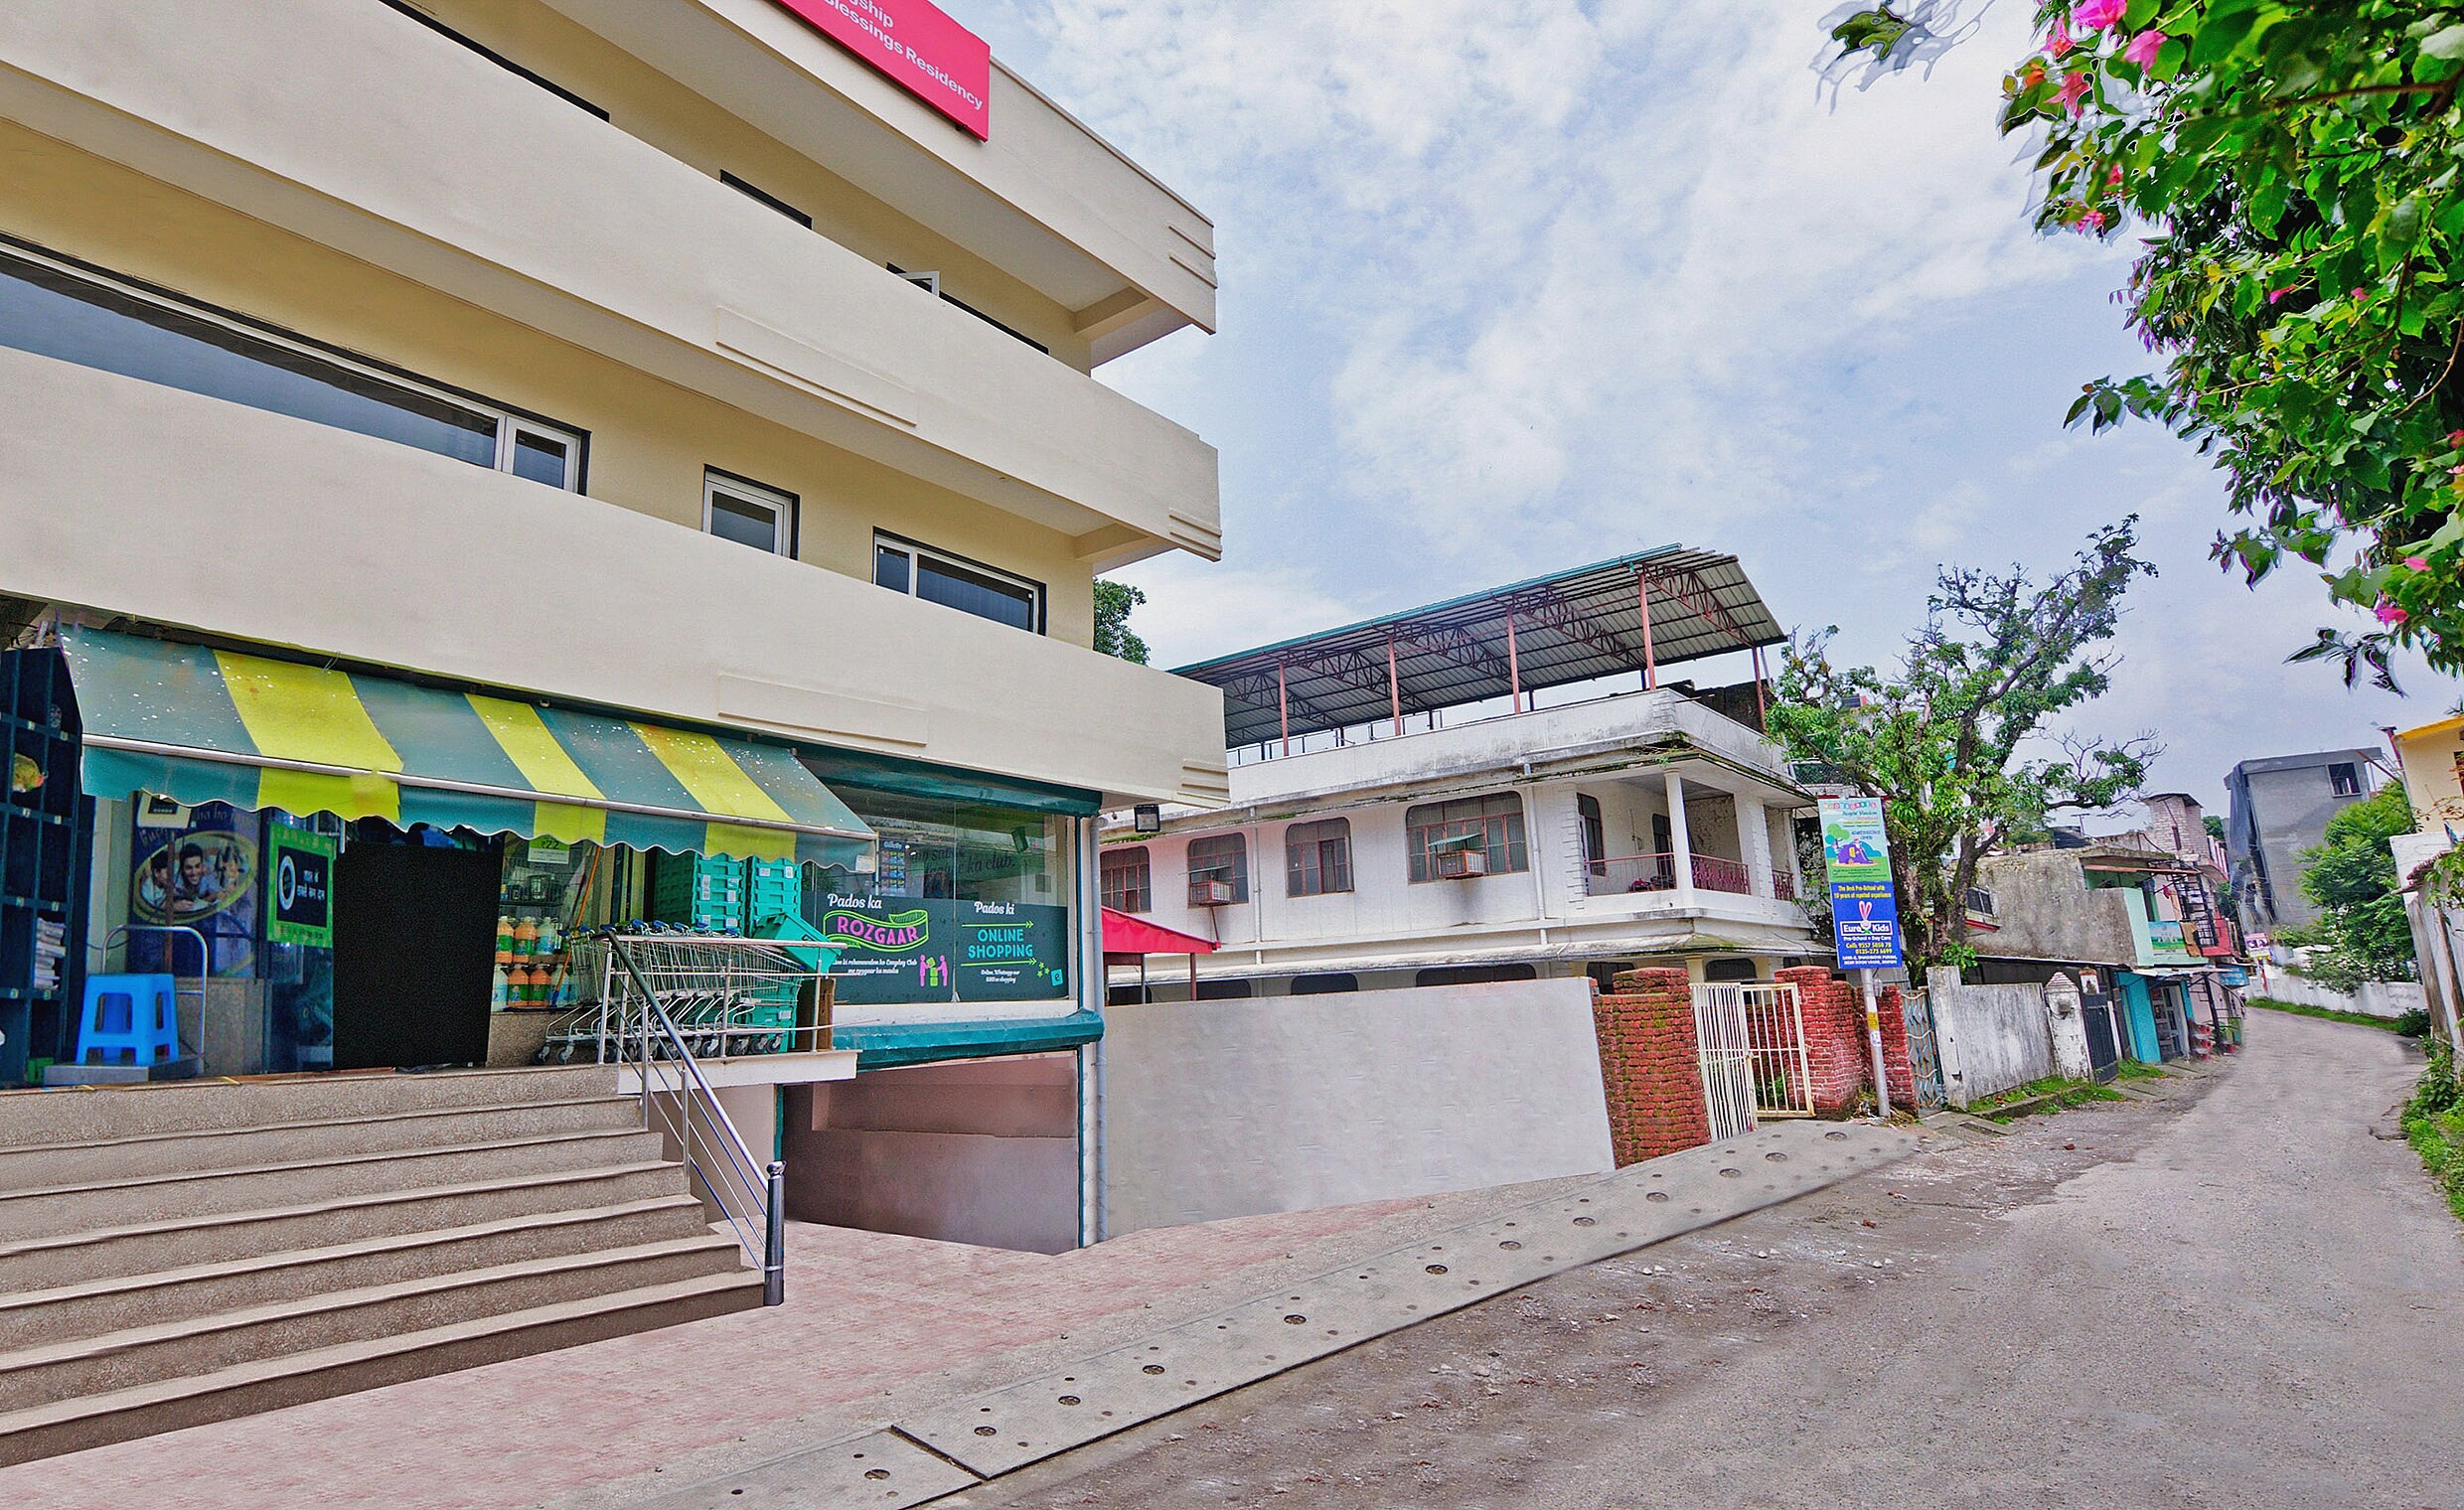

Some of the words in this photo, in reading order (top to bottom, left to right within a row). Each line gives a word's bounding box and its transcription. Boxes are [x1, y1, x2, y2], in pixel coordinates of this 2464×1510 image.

[905, 46, 983, 111] Residency
[827, 893, 866, 908] Pados
[867, 894, 882, 909] ka
[974, 901, 1004, 915] Pados
[1005, 902, 1015, 915] ki
[837, 916, 919, 945] ROZGAAR
[978, 929, 1024, 942] ONLINE
[1843, 924, 1862, 933] Euro
[1872, 924, 1890, 933] Kids
[968, 944, 1033, 959] SHOPPING
